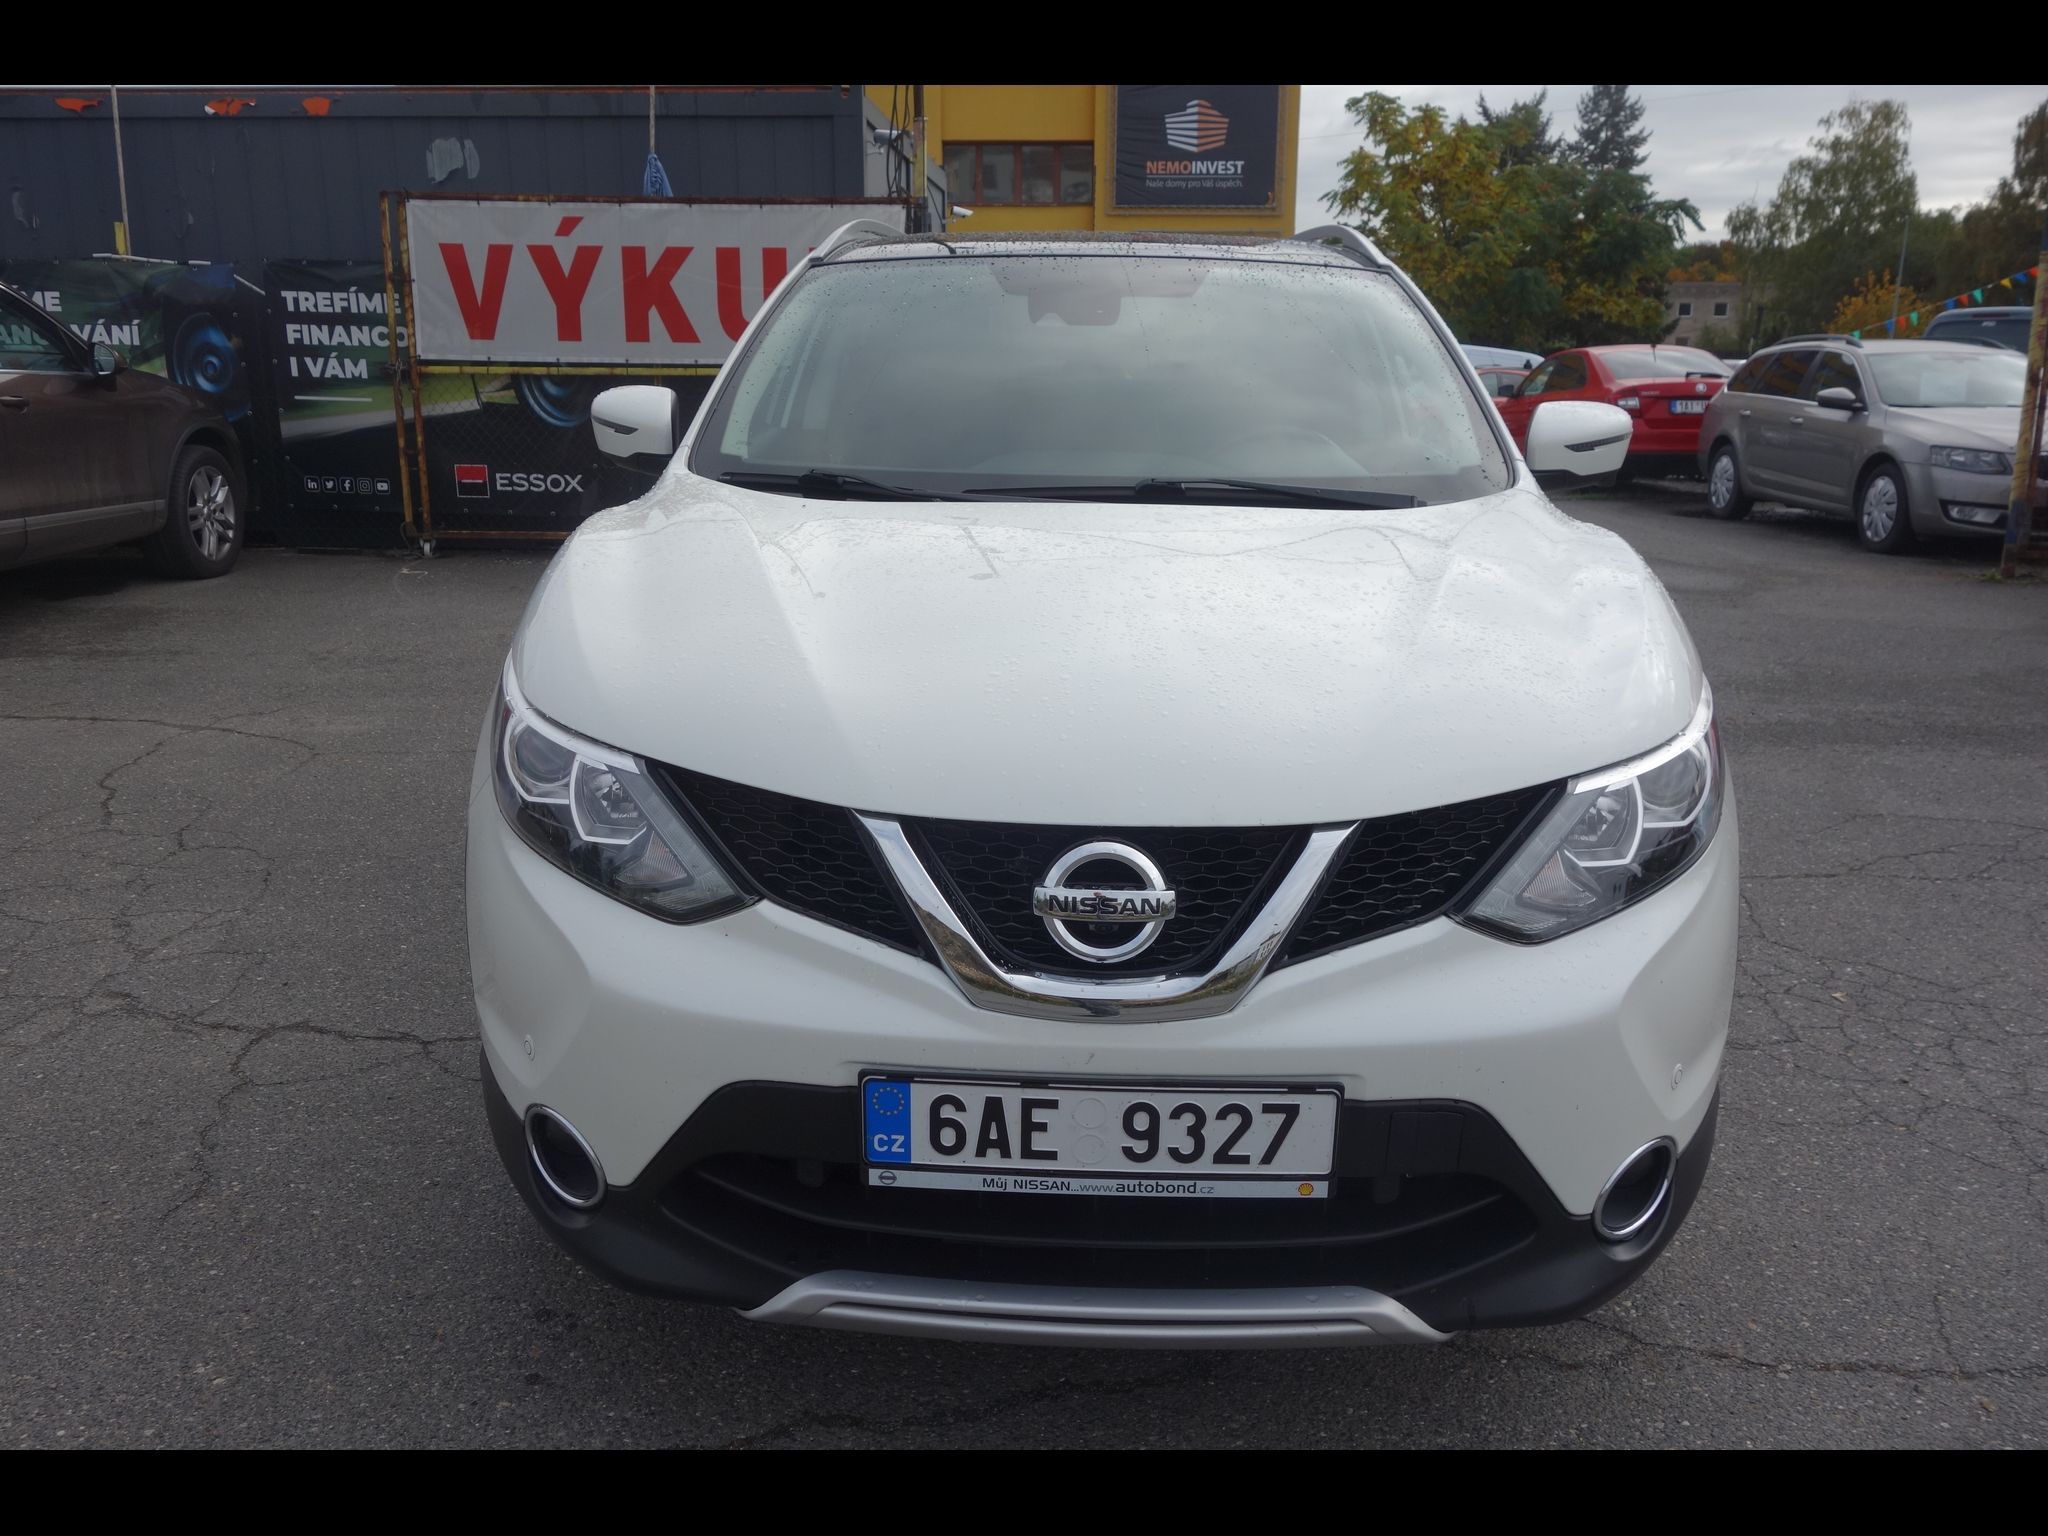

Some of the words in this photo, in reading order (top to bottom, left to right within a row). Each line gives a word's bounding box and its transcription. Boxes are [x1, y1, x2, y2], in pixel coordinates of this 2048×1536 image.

[1146, 160, 1244, 174] NEMOINVEST
[1165, 179, 1187, 190] domy
[1188, 180, 1200, 190] pro
[438, 216, 813, 343] VÝKU
[280, 287, 401, 314] TREFÍME
[286, 324, 409, 347] FINANCO
[289, 356, 299, 377] I
[304, 352, 368, 379] VÁM
[495, 472, 584, 493] ESSOX
[1048, 894, 1161, 915] NISSAN
[928, 1093, 1059, 1161] 6AE
[1121, 1101, 1301, 1166] 9327
[873, 1133, 905, 1154] CZ
[982, 1177, 1007, 1191] Můj
